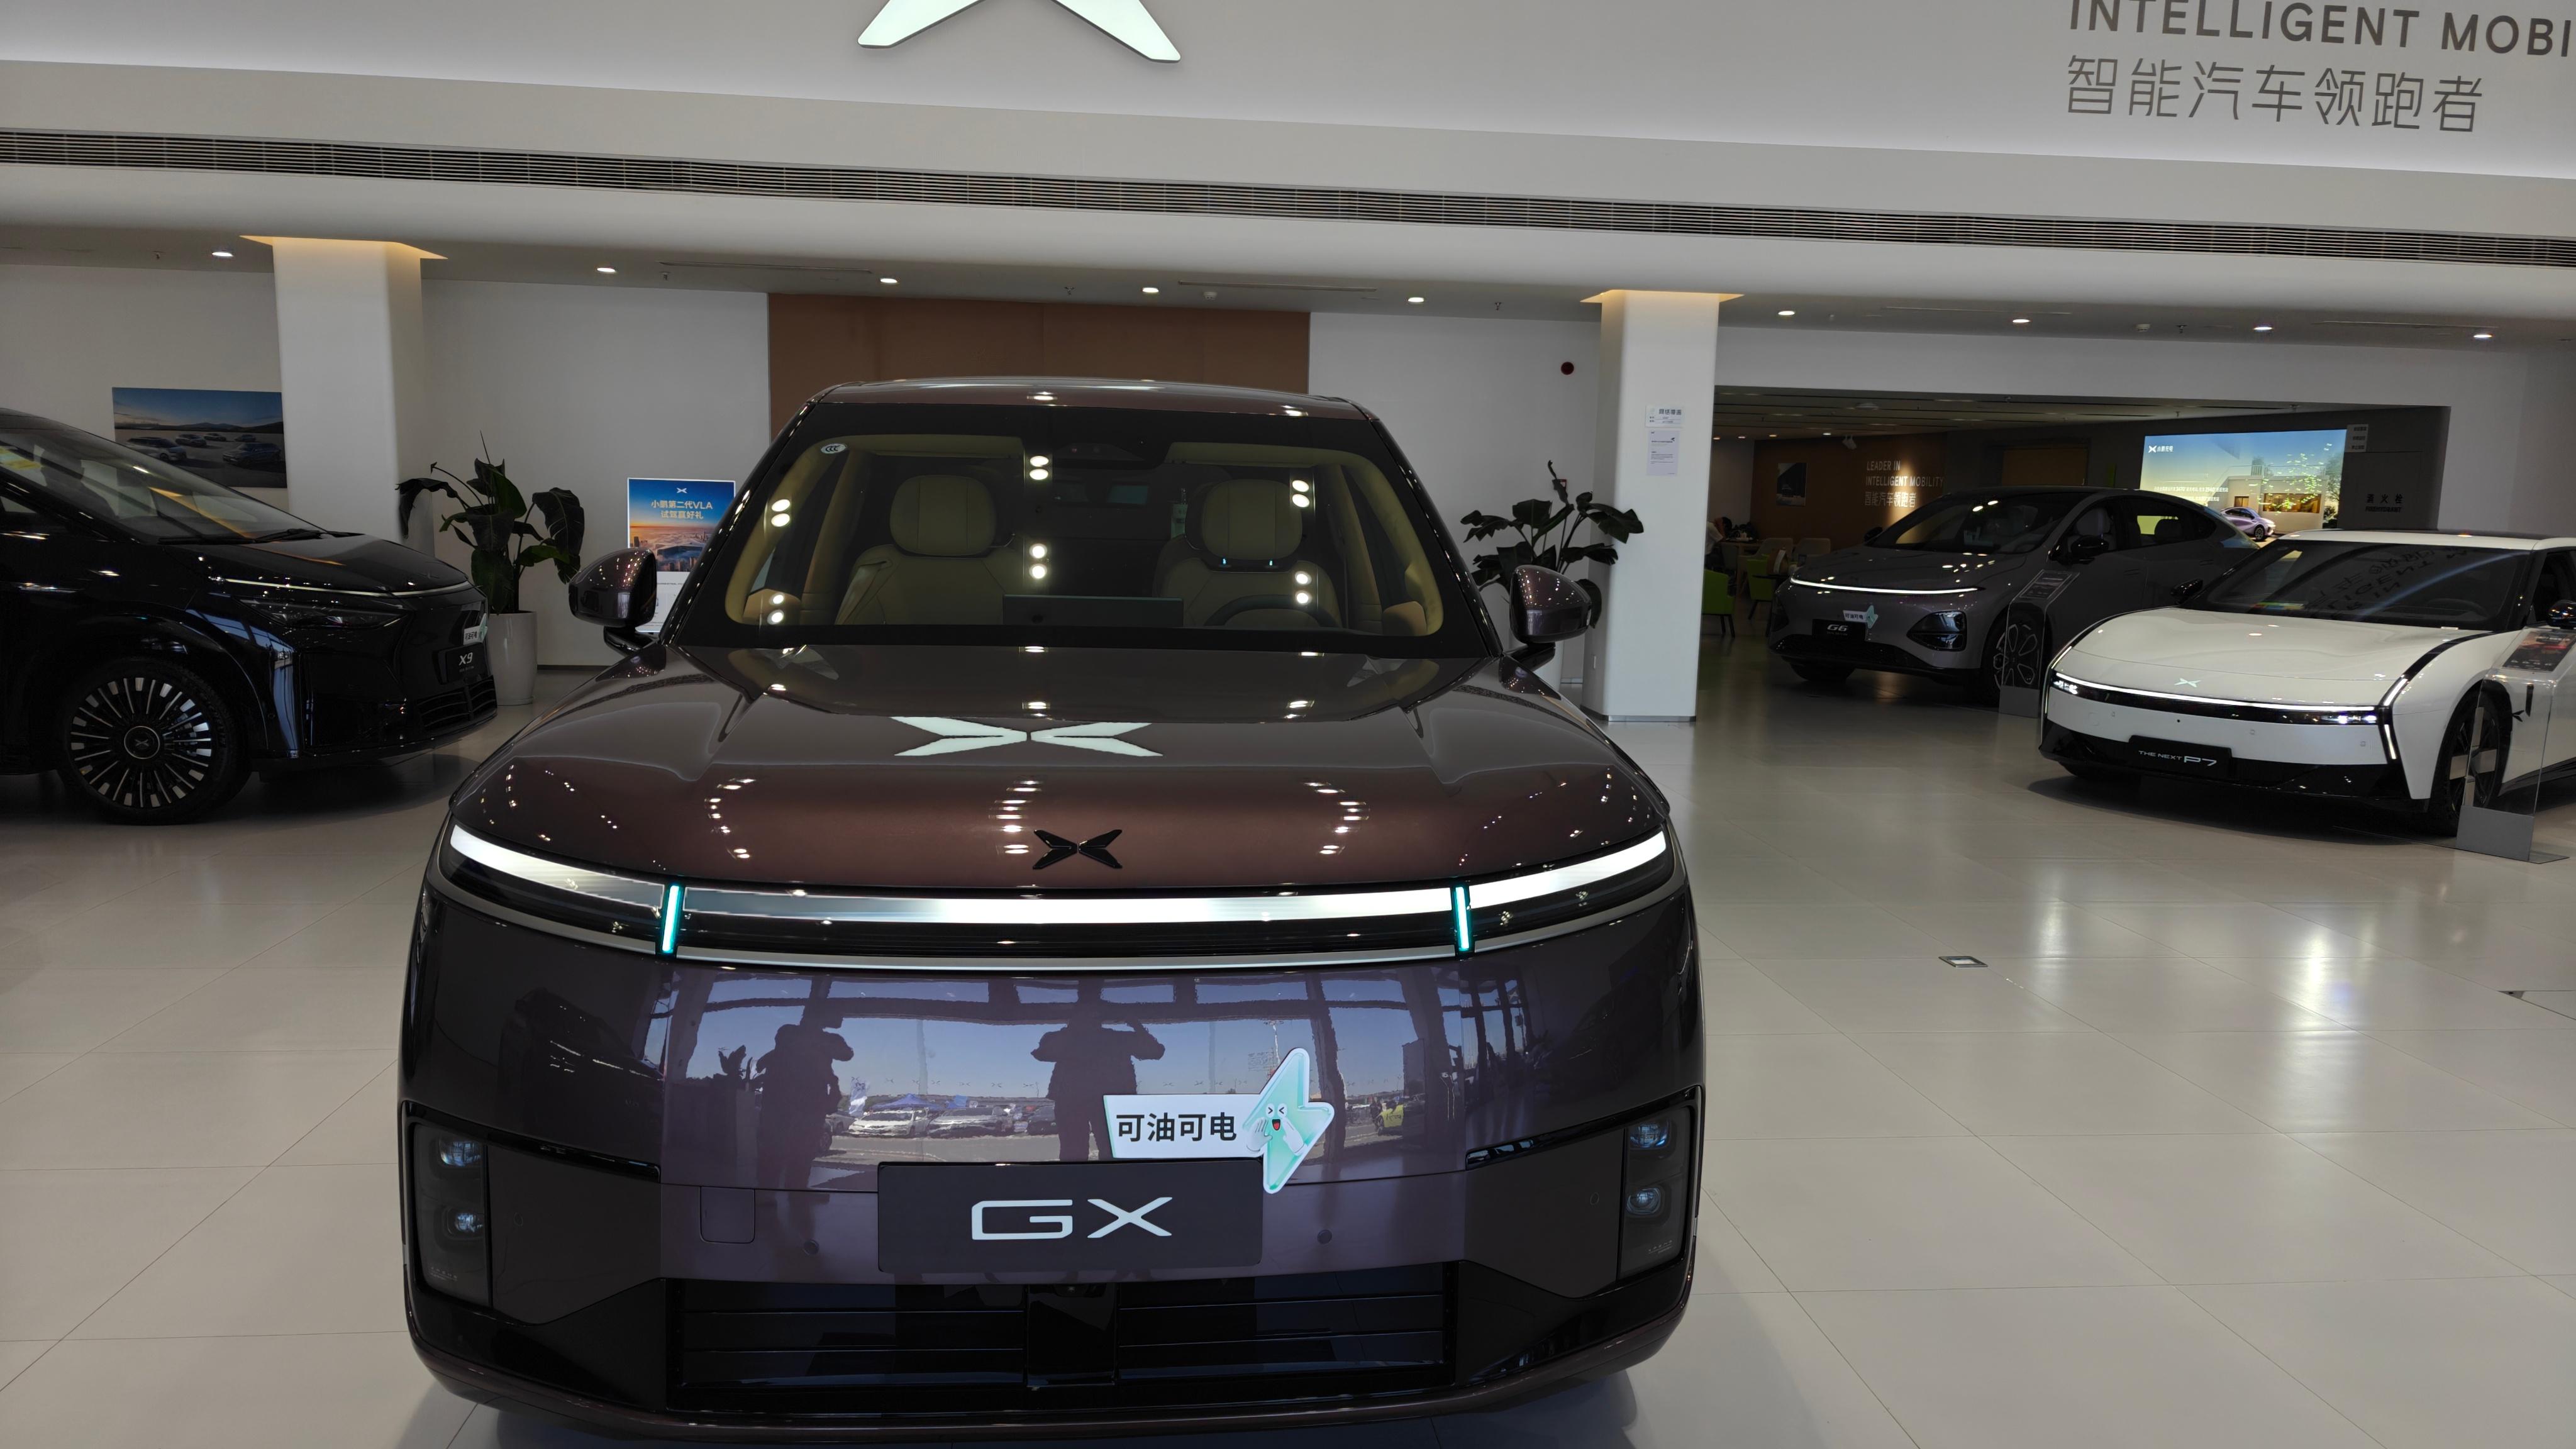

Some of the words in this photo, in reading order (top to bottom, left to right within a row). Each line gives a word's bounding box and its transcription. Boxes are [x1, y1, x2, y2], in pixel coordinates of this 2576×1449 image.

[2070, 0, 2419, 47] INTELLIGENT
[2441, 12, 2571, 57] MOBI
[2068, 55, 2483, 133] 智能汽车领跑者
[1867, 461, 1892, 470] LEADER
[1894, 460, 1901, 470] IN
[1866, 476, 1908, 486] INTELLIGENT
[1910, 477, 1943, 487] MOBILITY
[1865, 491, 1916, 508] 智能汽车领跑者
[458, 652, 473, 665] X9
[2184, 756, 2217, 766] P7
[1116, 1112, 1237, 1143] 可油可电
[971, 1197, 1173, 1240] GX
